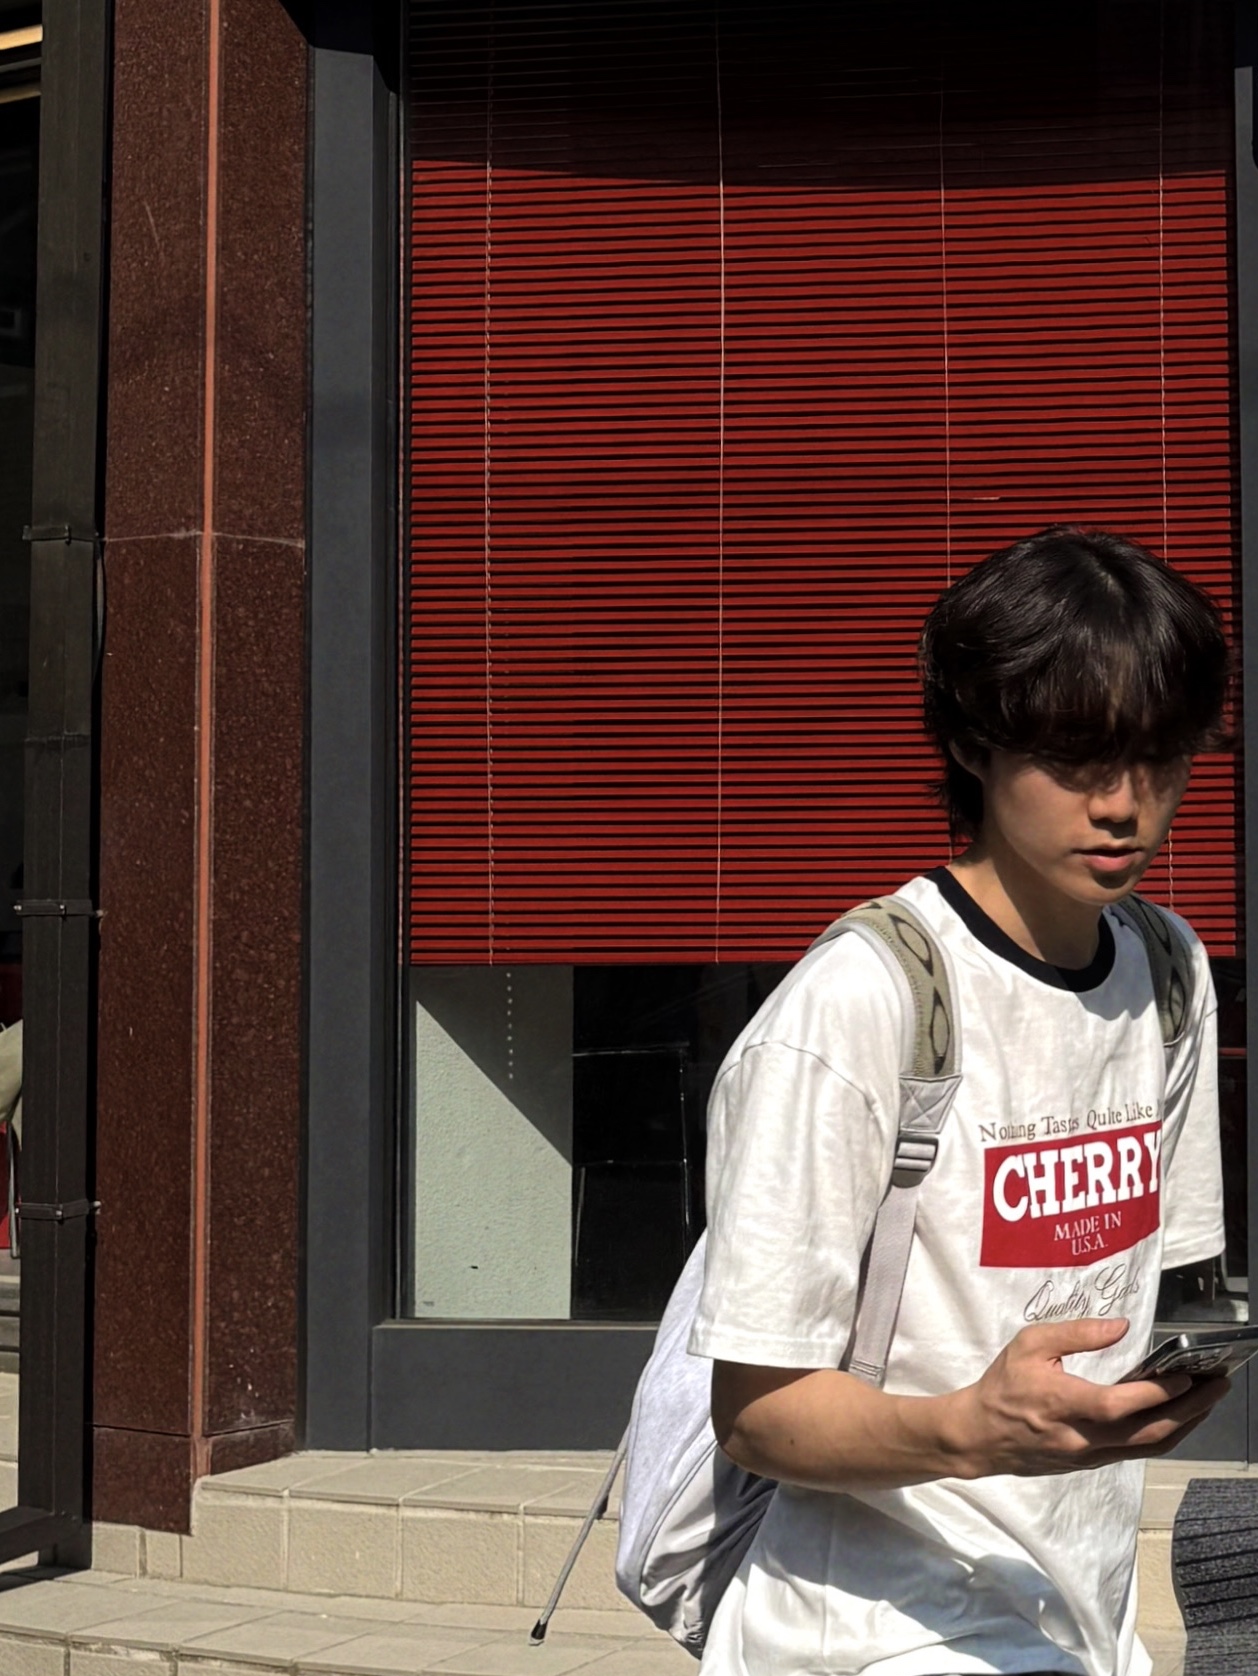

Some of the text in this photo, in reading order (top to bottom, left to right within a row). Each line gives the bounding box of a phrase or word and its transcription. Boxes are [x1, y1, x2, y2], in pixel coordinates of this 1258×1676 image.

[978, 1122, 1036, 1143] Noing
[1125, 1101, 1153, 1122] Like
[993, 1128, 1162, 1222] CHERRY
[1054, 1211, 1122, 1241] MADE IN
[1071, 1233, 1109, 1256] U.S.A.
[1023, 1279, 1091, 1323] Quality
